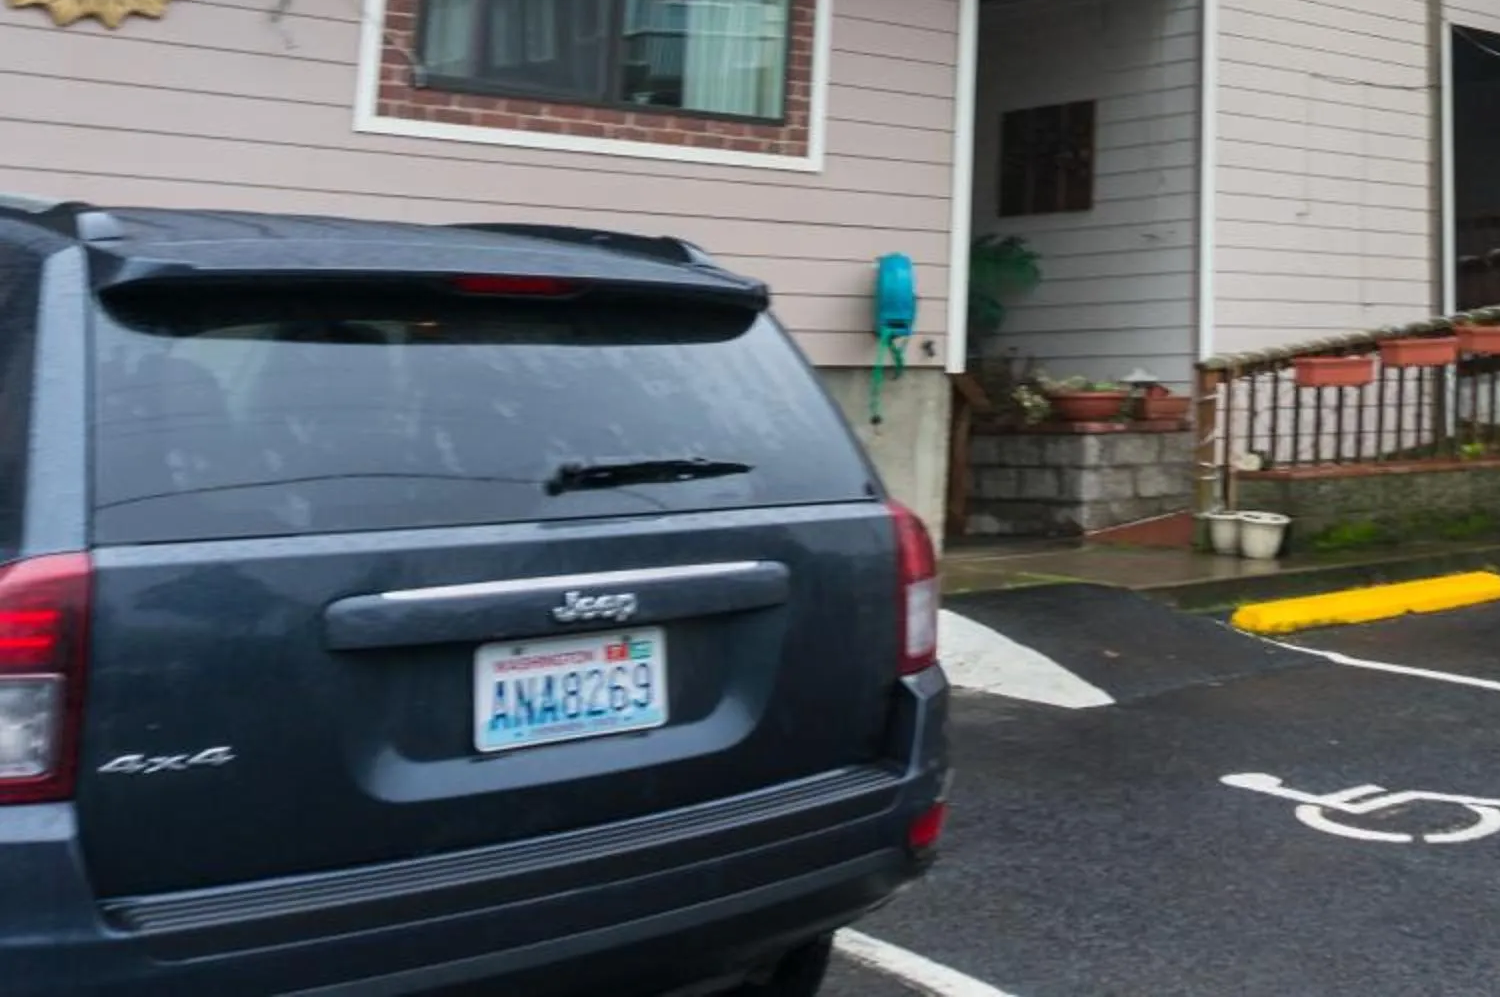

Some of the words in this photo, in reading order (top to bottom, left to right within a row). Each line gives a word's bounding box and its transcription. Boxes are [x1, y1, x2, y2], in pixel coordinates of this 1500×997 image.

[553, 591, 637, 621] Jeep
[489, 663, 654, 730] ANA8269
[97, 746, 236, 774] 4x4
